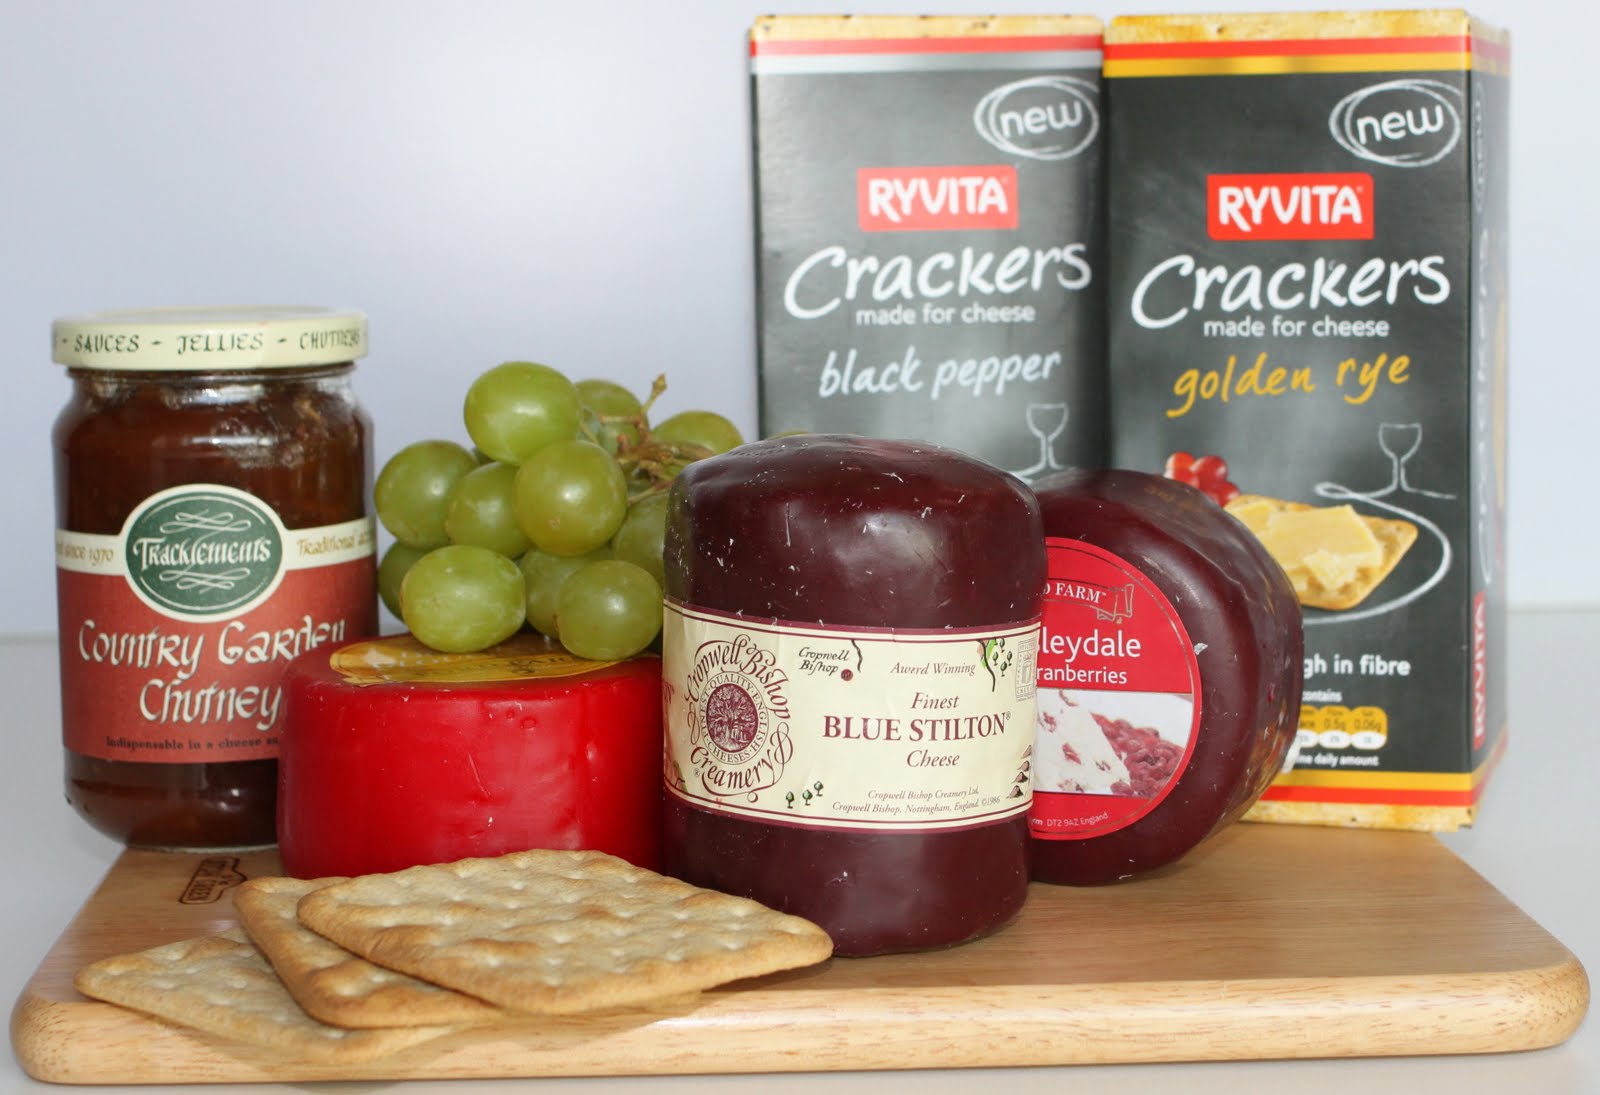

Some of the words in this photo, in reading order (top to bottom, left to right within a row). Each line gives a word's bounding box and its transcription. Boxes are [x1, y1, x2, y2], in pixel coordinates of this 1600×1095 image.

[1000, 100, 1084, 138] new
[1356, 104, 1444, 145] new
[868, 176, 1008, 222] RYVITA
[1218, 185, 1363, 232] RYVITA
[783, 242, 1093, 319] Crackers
[1131, 254, 1451, 329] Crackers
[855, 302, 916, 326] made
[922, 302, 955, 325] for
[961, 301, 1037, 324] cheese
[1203, 314, 1265, 338] made
[1272, 314, 1306, 337] for
[1312, 313, 1390, 337] cheese
[74, 333, 140, 353] SAUCES
[177, 332, 265, 355] JELLIES
[818, 345, 925, 398] black
[930, 351, 1063, 401] pepper
[1166, 352, 1316, 418] golden
[1336, 352, 1411, 405] rye
[132, 535, 273, 571] Tracklements
[1055, 582, 1100, 604] FARM
[78, 619, 204, 681] Country
[217, 615, 346, 666] Garden
[798, 646, 851, 662] Cropwell
[1042, 626, 1142, 663] leydale
[684, 633, 751, 702] Cropwell
[739, 643, 792, 720] Bishop
[890, 661, 930, 675] Award
[933, 661, 976, 676] Winning
[1036, 663, 1128, 685] ranberries
[1303, 652, 1328, 680] gh
[1333, 654, 1354, 676] in
[1359, 654, 1412, 677] fibre
[709, 672, 753, 691] QUALITY
[139, 678, 283, 731] Chutney
[910, 691, 960, 710] Finest
[751, 691, 770, 753] ENGLISH
[822, 715, 902, 741] BLUE
[106, 735, 183, 751] Indispensable
[188, 739, 201, 750] in
[206, 742, 214, 750] a
[218, 738, 262, 750] cheese
[706, 739, 752, 764] CHEESES
[689, 745, 776, 791] Creamery
[906, 749, 960, 768] Cheese
[1314, 752, 1338, 768] daily
[1340, 755, 1379, 767] amount
[832, 801, 870, 814] Cropwell
[867, 789, 906, 801] Cropwell
[907, 789, 933, 801] Bishop
[935, 788, 968, 799] Creamery
[1046, 818, 1063, 827] DT2
[1080, 811, 1109, 826] England
